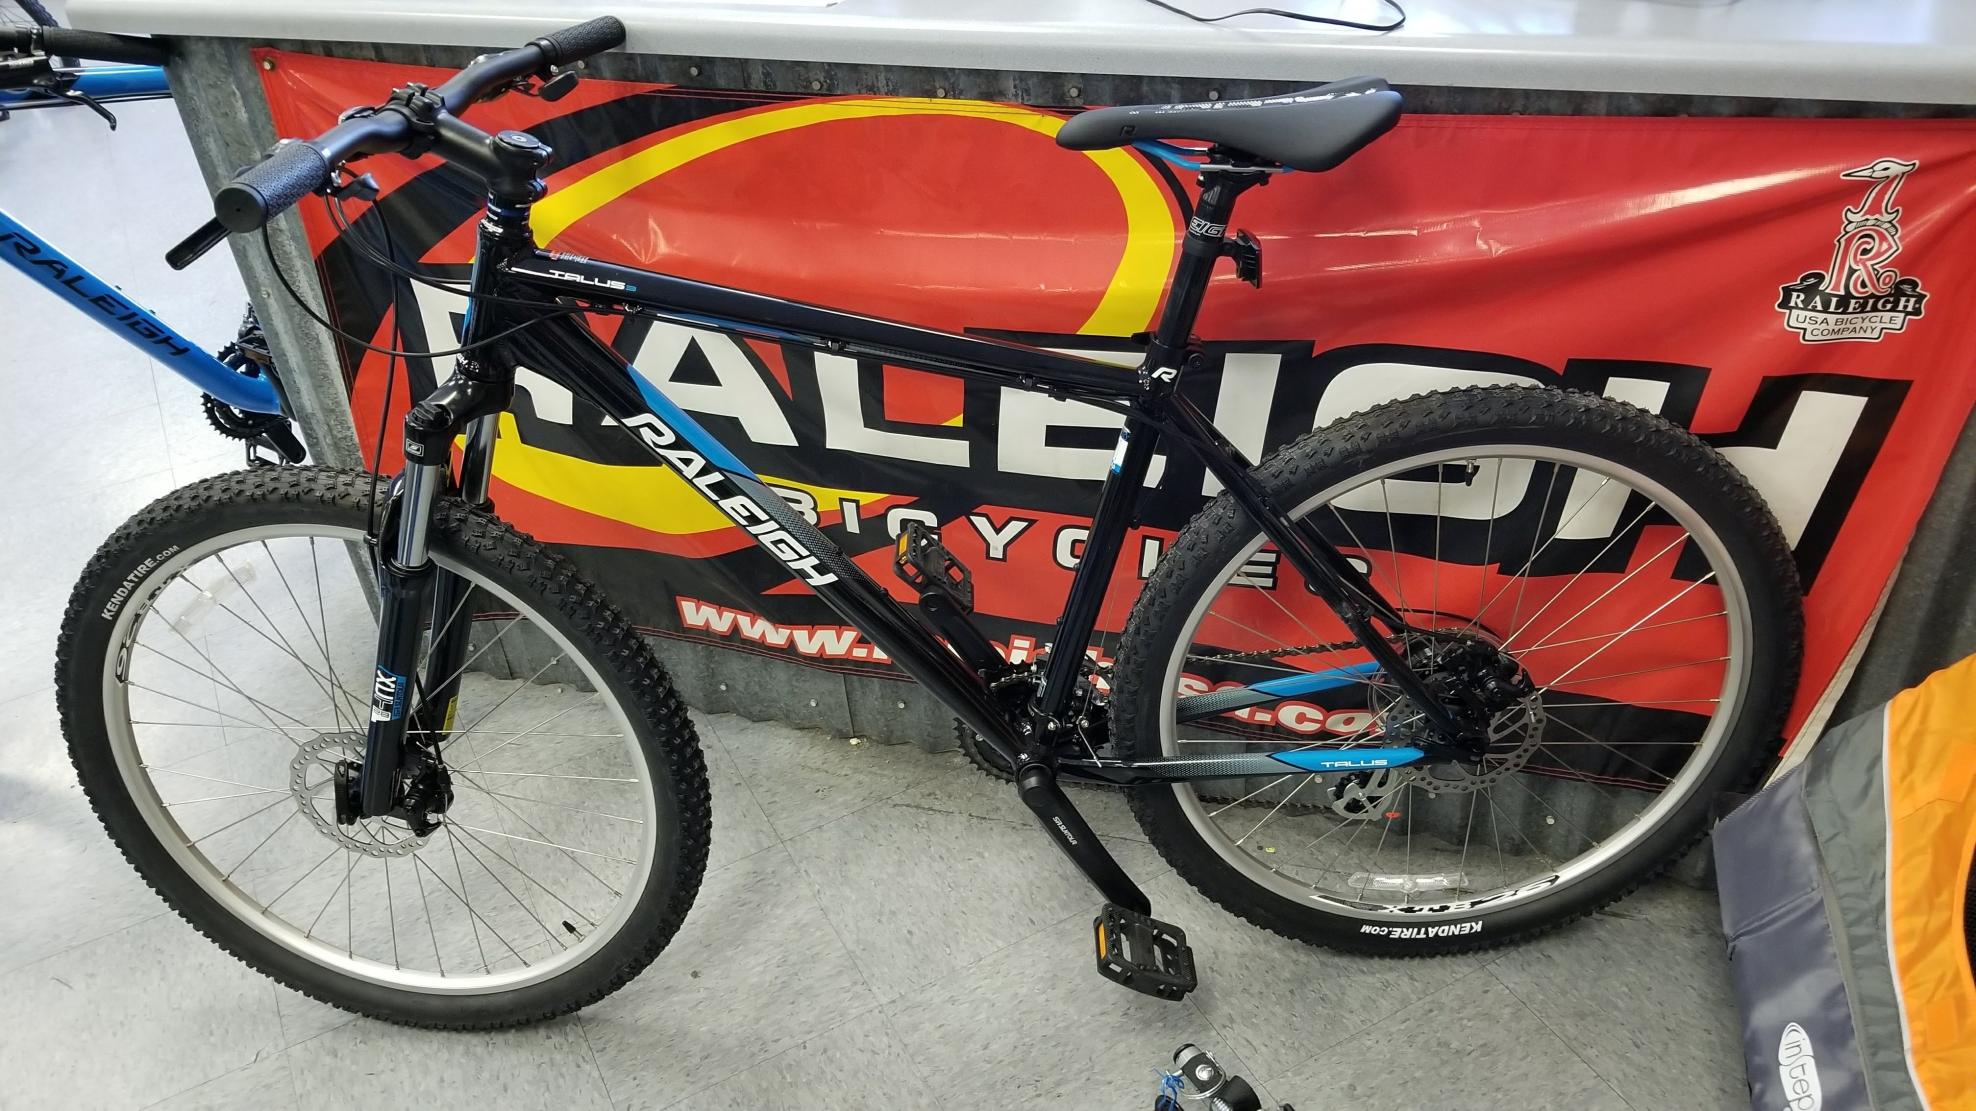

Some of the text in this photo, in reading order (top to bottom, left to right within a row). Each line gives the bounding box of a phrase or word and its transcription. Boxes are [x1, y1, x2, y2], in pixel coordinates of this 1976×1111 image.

[0, 232, 191, 356] RALEIGH
[1788, 291, 1918, 313] RALEIGH
[1796, 314, 1900, 326] USA BICYCLE
[1810, 325, 1878, 337] COMPANY
[621, 413, 839, 586] RALEIGH
[101, 544, 180, 621] KENDATIRE.COM
[1321, 759, 1388, 768] TALUS
[1360, 920, 1483, 940] KENDATIRE.COM
